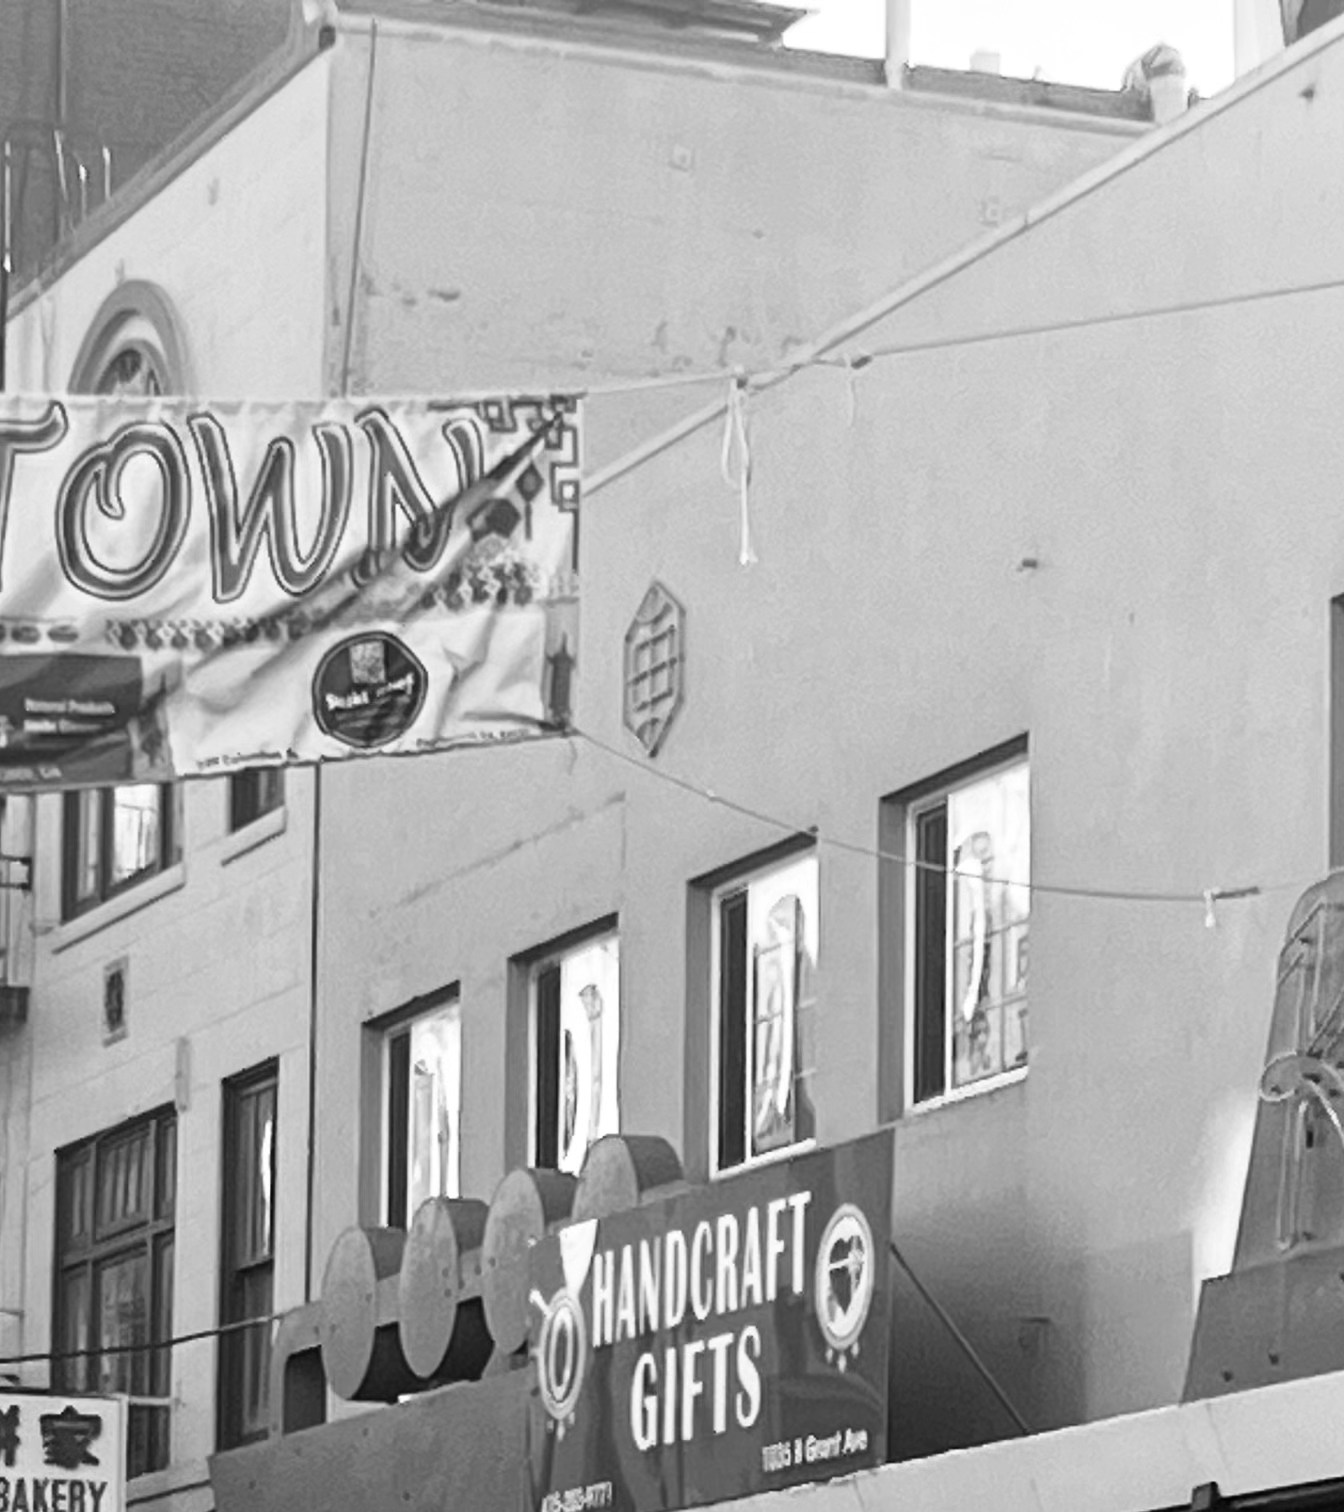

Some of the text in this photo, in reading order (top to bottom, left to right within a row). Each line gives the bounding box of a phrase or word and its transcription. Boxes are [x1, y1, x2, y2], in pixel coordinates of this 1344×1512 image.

[592, 1191, 811, 1348] HANDCRAFT
[630, 1325, 761, 1452] GIFTS
[842, 1428, 868, 1454] Ave
